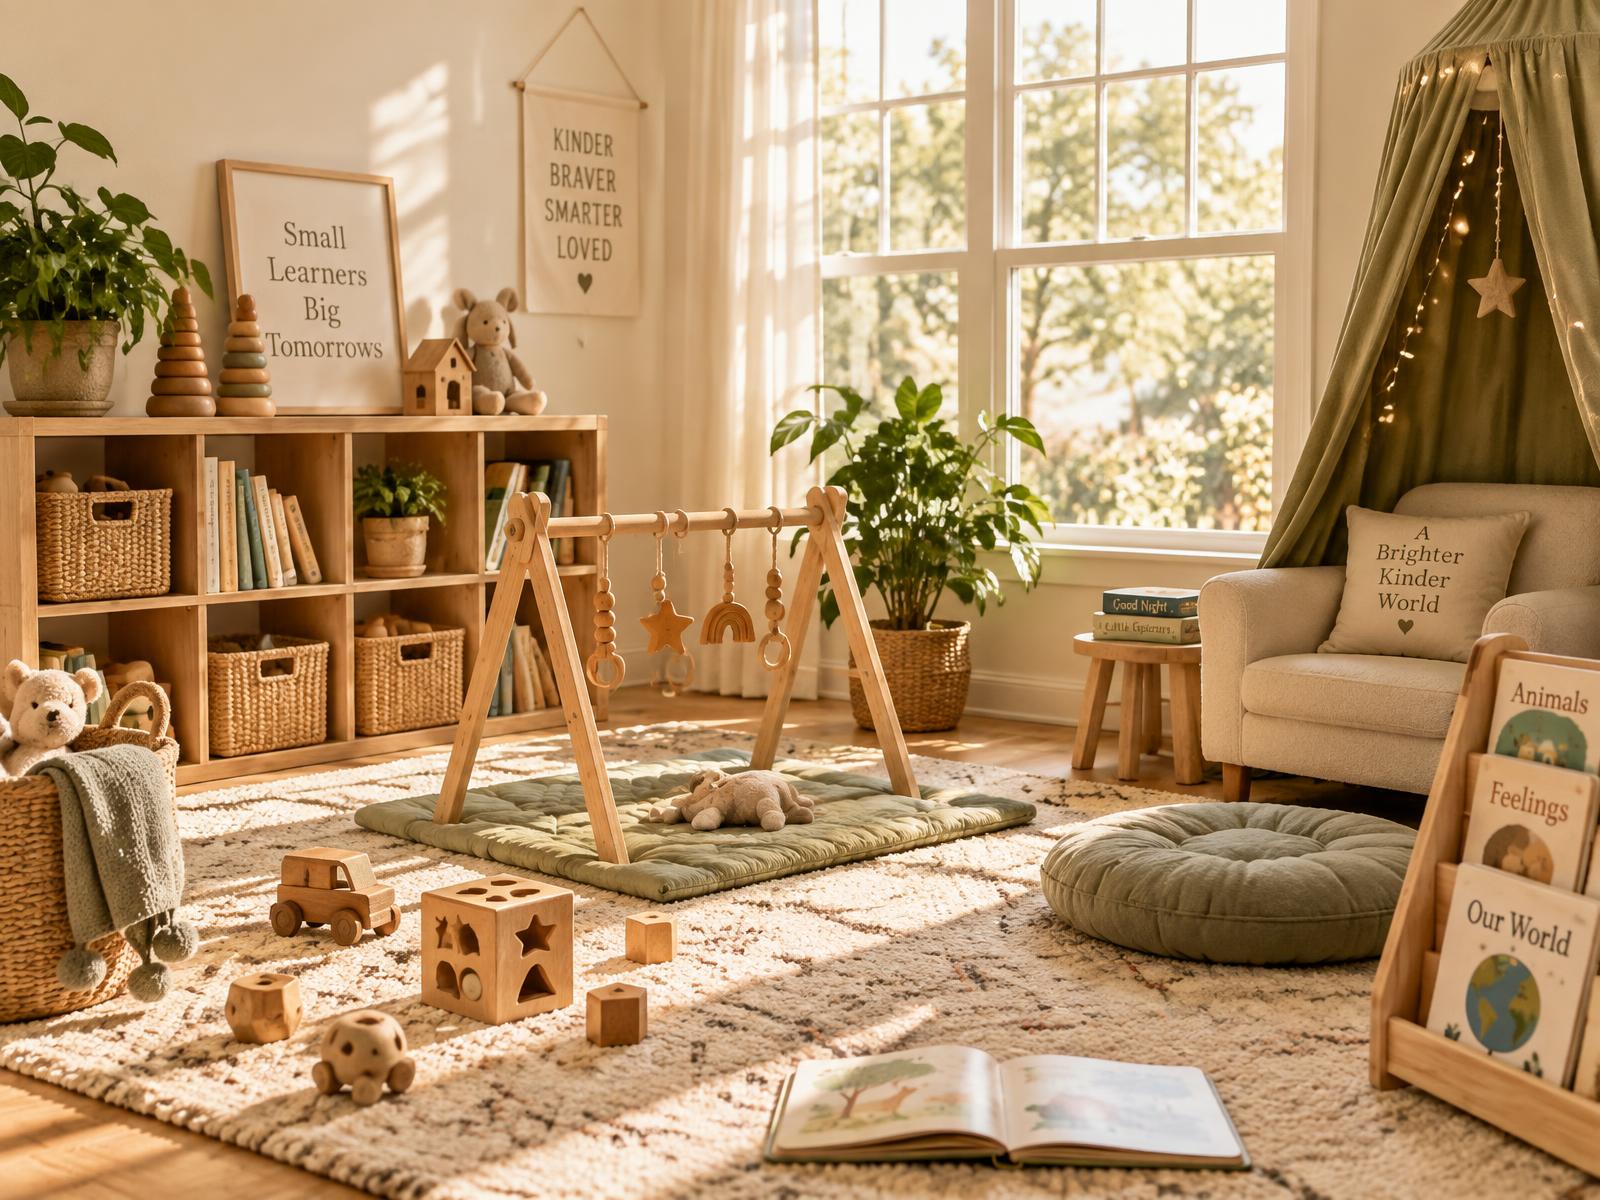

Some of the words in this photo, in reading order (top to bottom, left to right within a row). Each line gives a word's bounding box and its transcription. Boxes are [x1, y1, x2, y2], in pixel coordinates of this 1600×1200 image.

[553, 127, 614, 158] KINDER
[550, 162, 617, 193] BRAVER
[545, 198, 623, 228] SMARTER
[284, 221, 346, 250] Small
[557, 235, 613, 262] LOVED
[267, 256, 368, 287] Learners
[303, 295, 342, 329] Big
[265, 332, 384, 360] Tomorrows
[1414, 526, 1430, 541] A
[1376, 543, 1465, 567] Brighter
[1378, 567, 1452, 589] Kinder
[1112, 598, 1138, 611] Good
[1378, 592, 1441, 614] World
[1510, 681, 1589, 715] Animals
[1490, 780, 1570, 827] Feelings
[1467, 899, 1505, 933] Our
[1510, 910, 1574, 958] World
